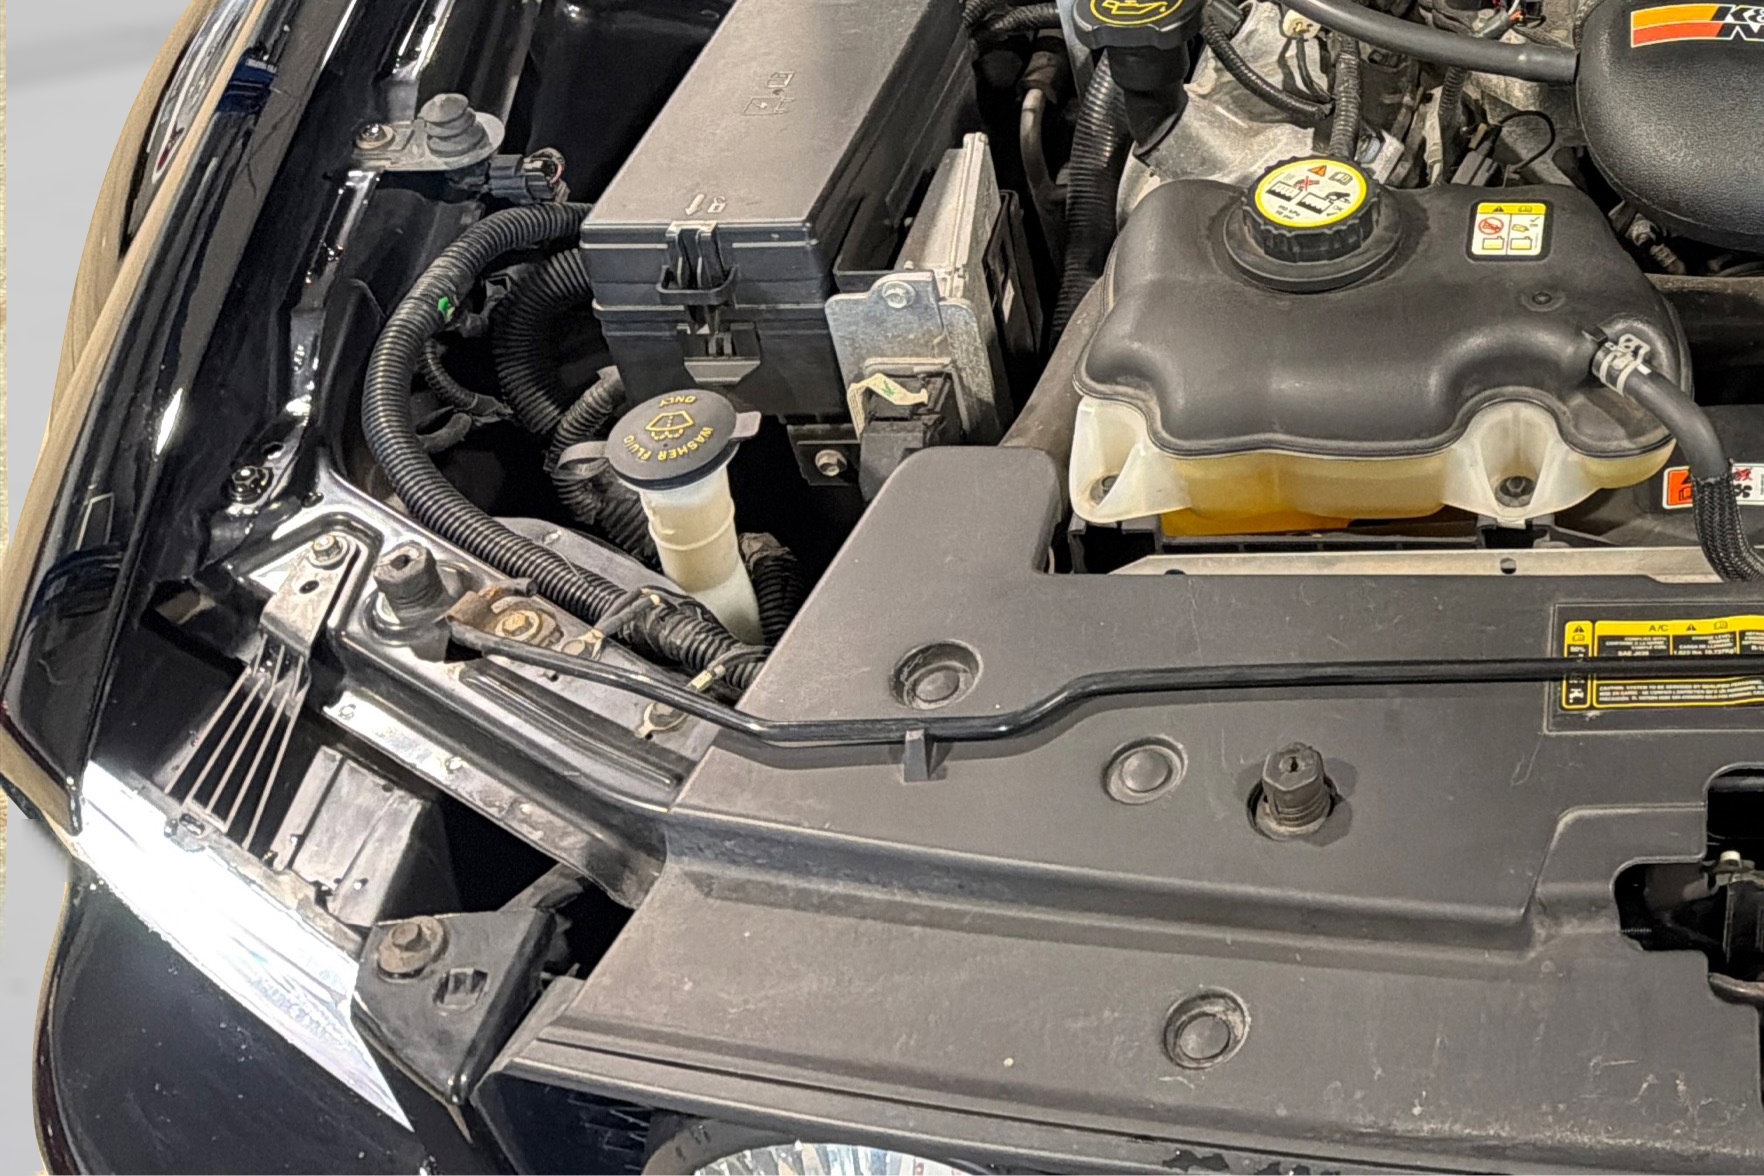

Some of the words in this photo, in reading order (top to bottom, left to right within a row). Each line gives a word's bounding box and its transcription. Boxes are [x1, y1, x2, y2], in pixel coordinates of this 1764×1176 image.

[659, 395, 698, 407] ONLY
[623, 434, 653, 461] FLUID
[656, 426, 714, 461] WASHER
[1648, 624, 1669, 632] A/C
